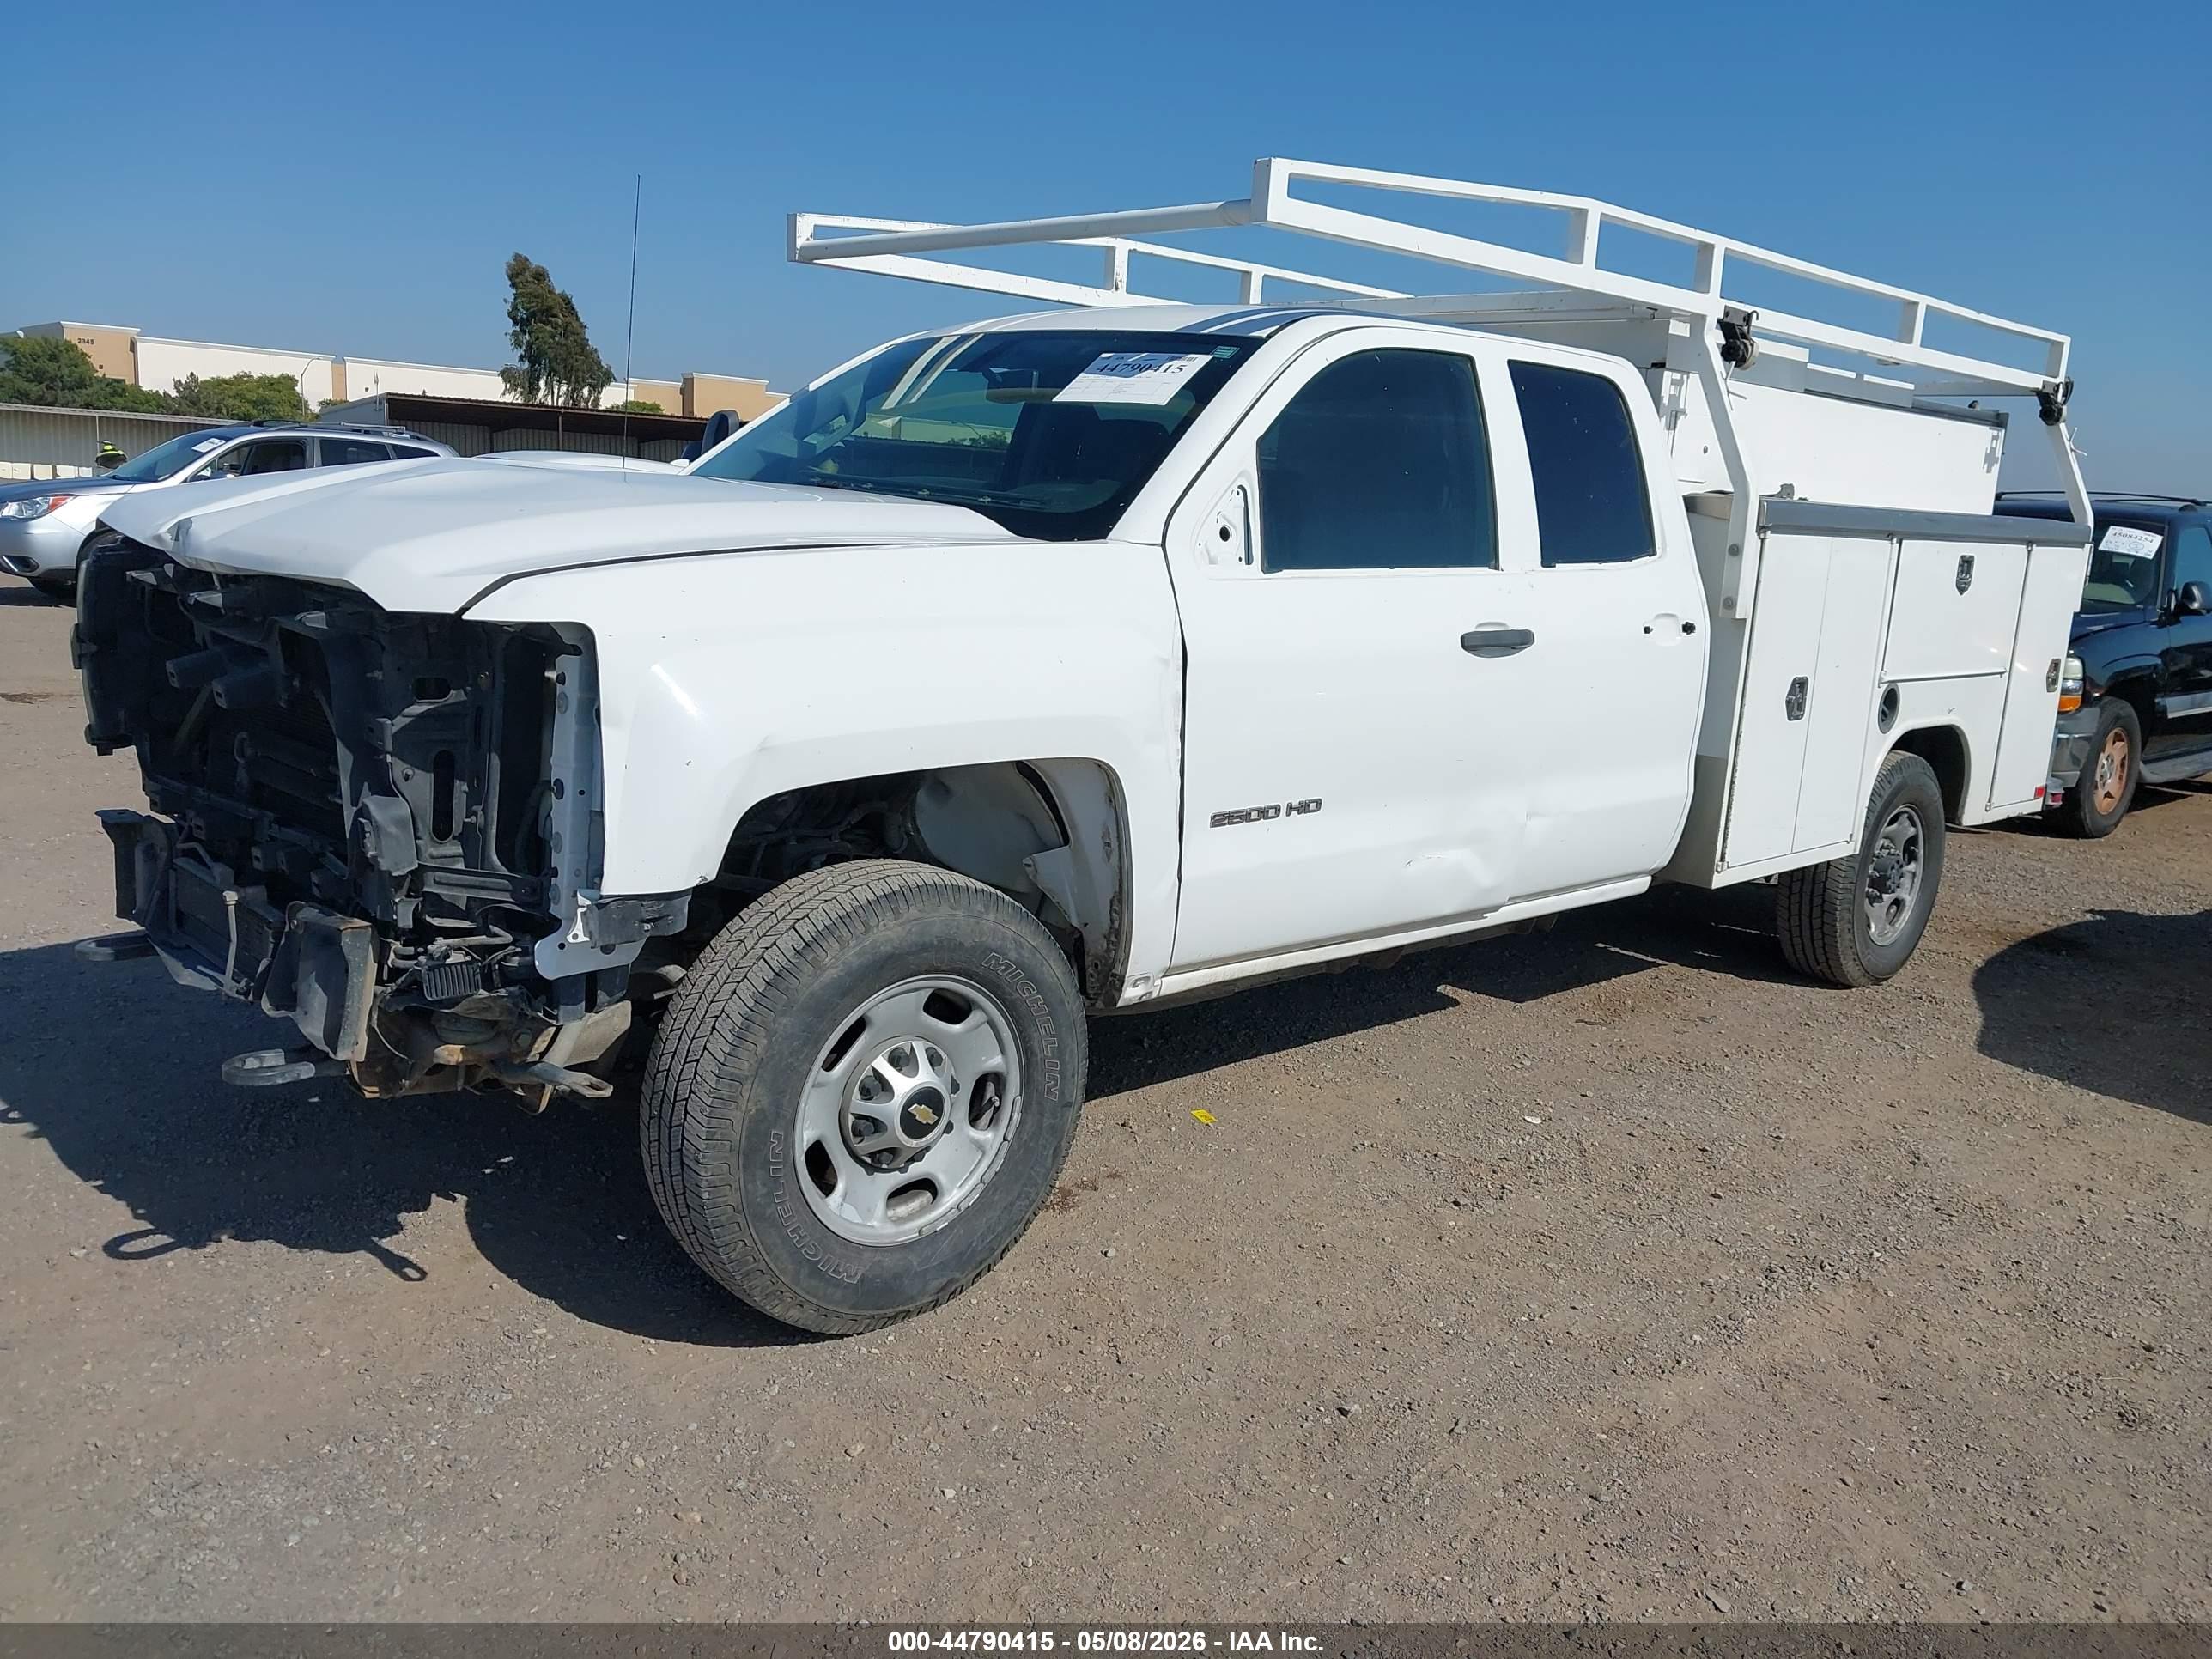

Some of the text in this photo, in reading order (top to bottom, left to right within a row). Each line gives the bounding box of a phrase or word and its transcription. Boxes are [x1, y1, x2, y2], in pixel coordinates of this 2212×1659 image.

[1096, 362, 1189, 374] 44790415
[1210, 798, 1322, 828] 2500 HD
[981, 951, 1060, 1101] MICHELIN
[769, 1130, 863, 1285] MICHELIN
